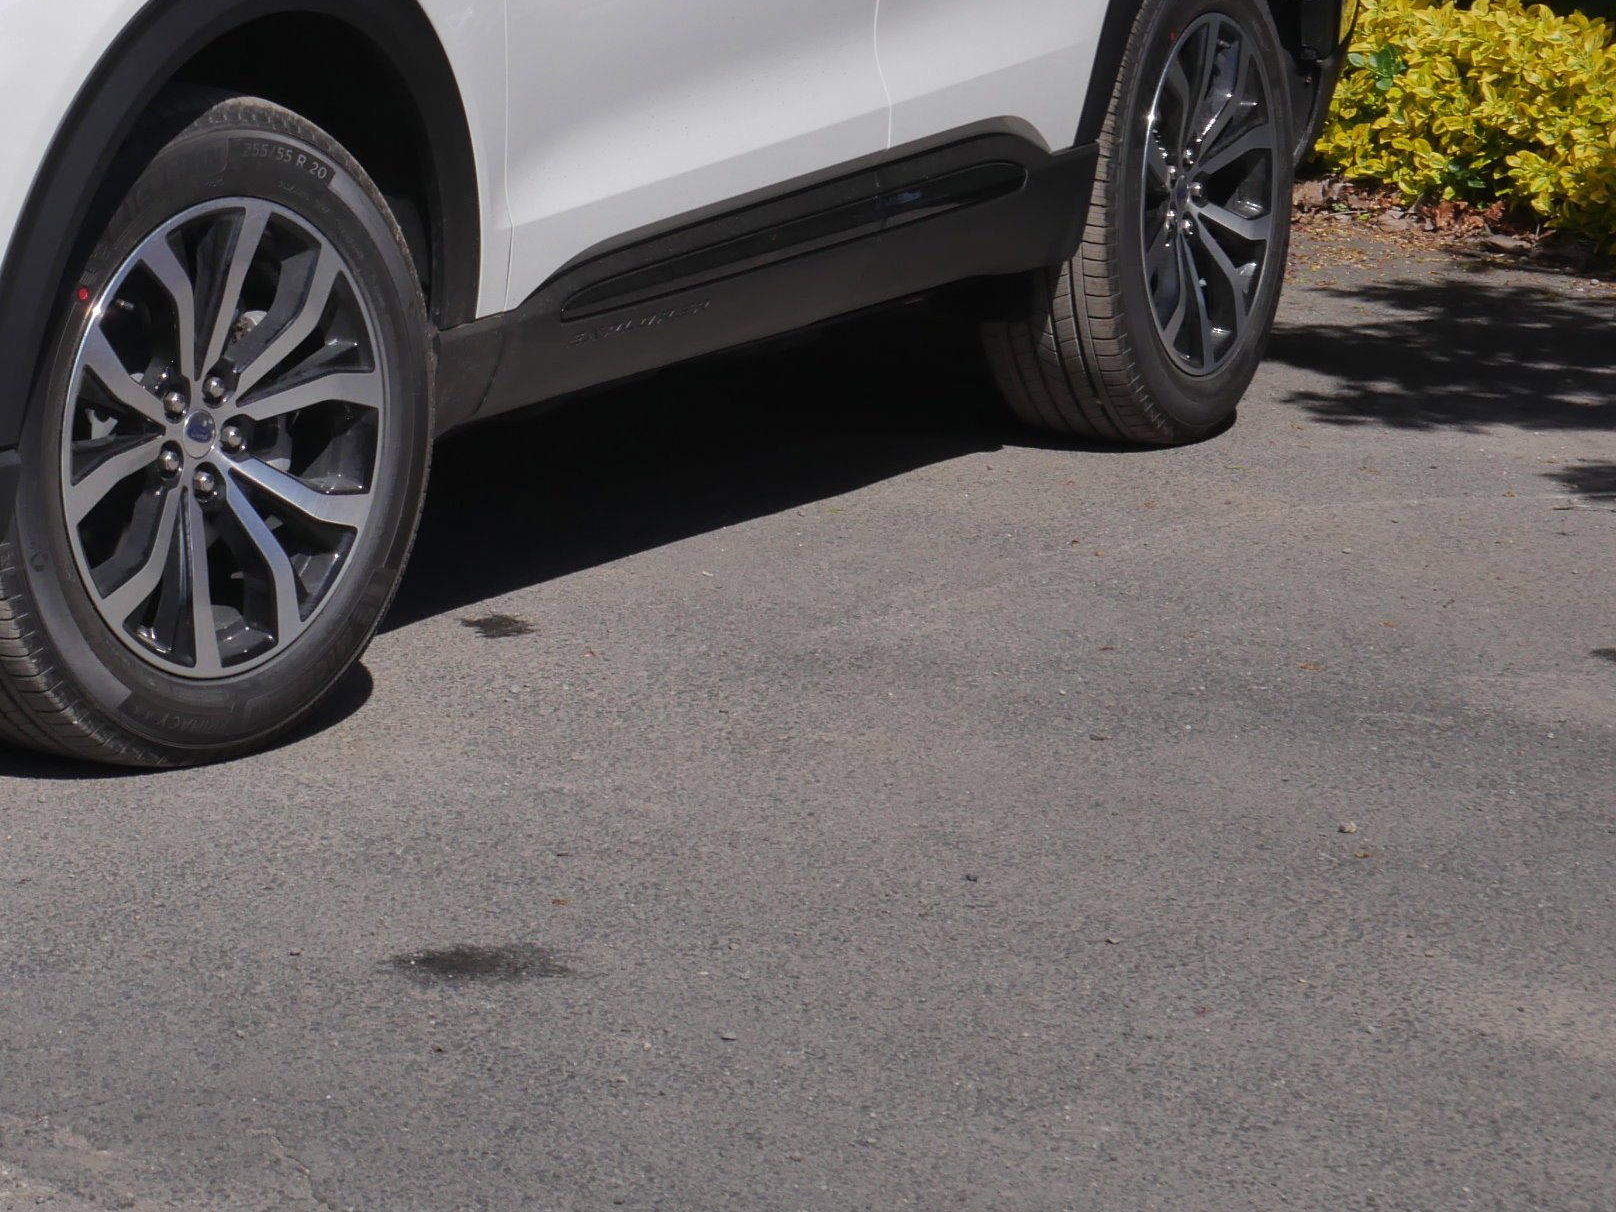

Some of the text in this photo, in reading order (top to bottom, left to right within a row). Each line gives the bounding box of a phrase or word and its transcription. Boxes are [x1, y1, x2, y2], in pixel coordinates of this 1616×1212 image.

[242, 142, 328, 180] 255/55 R 20
